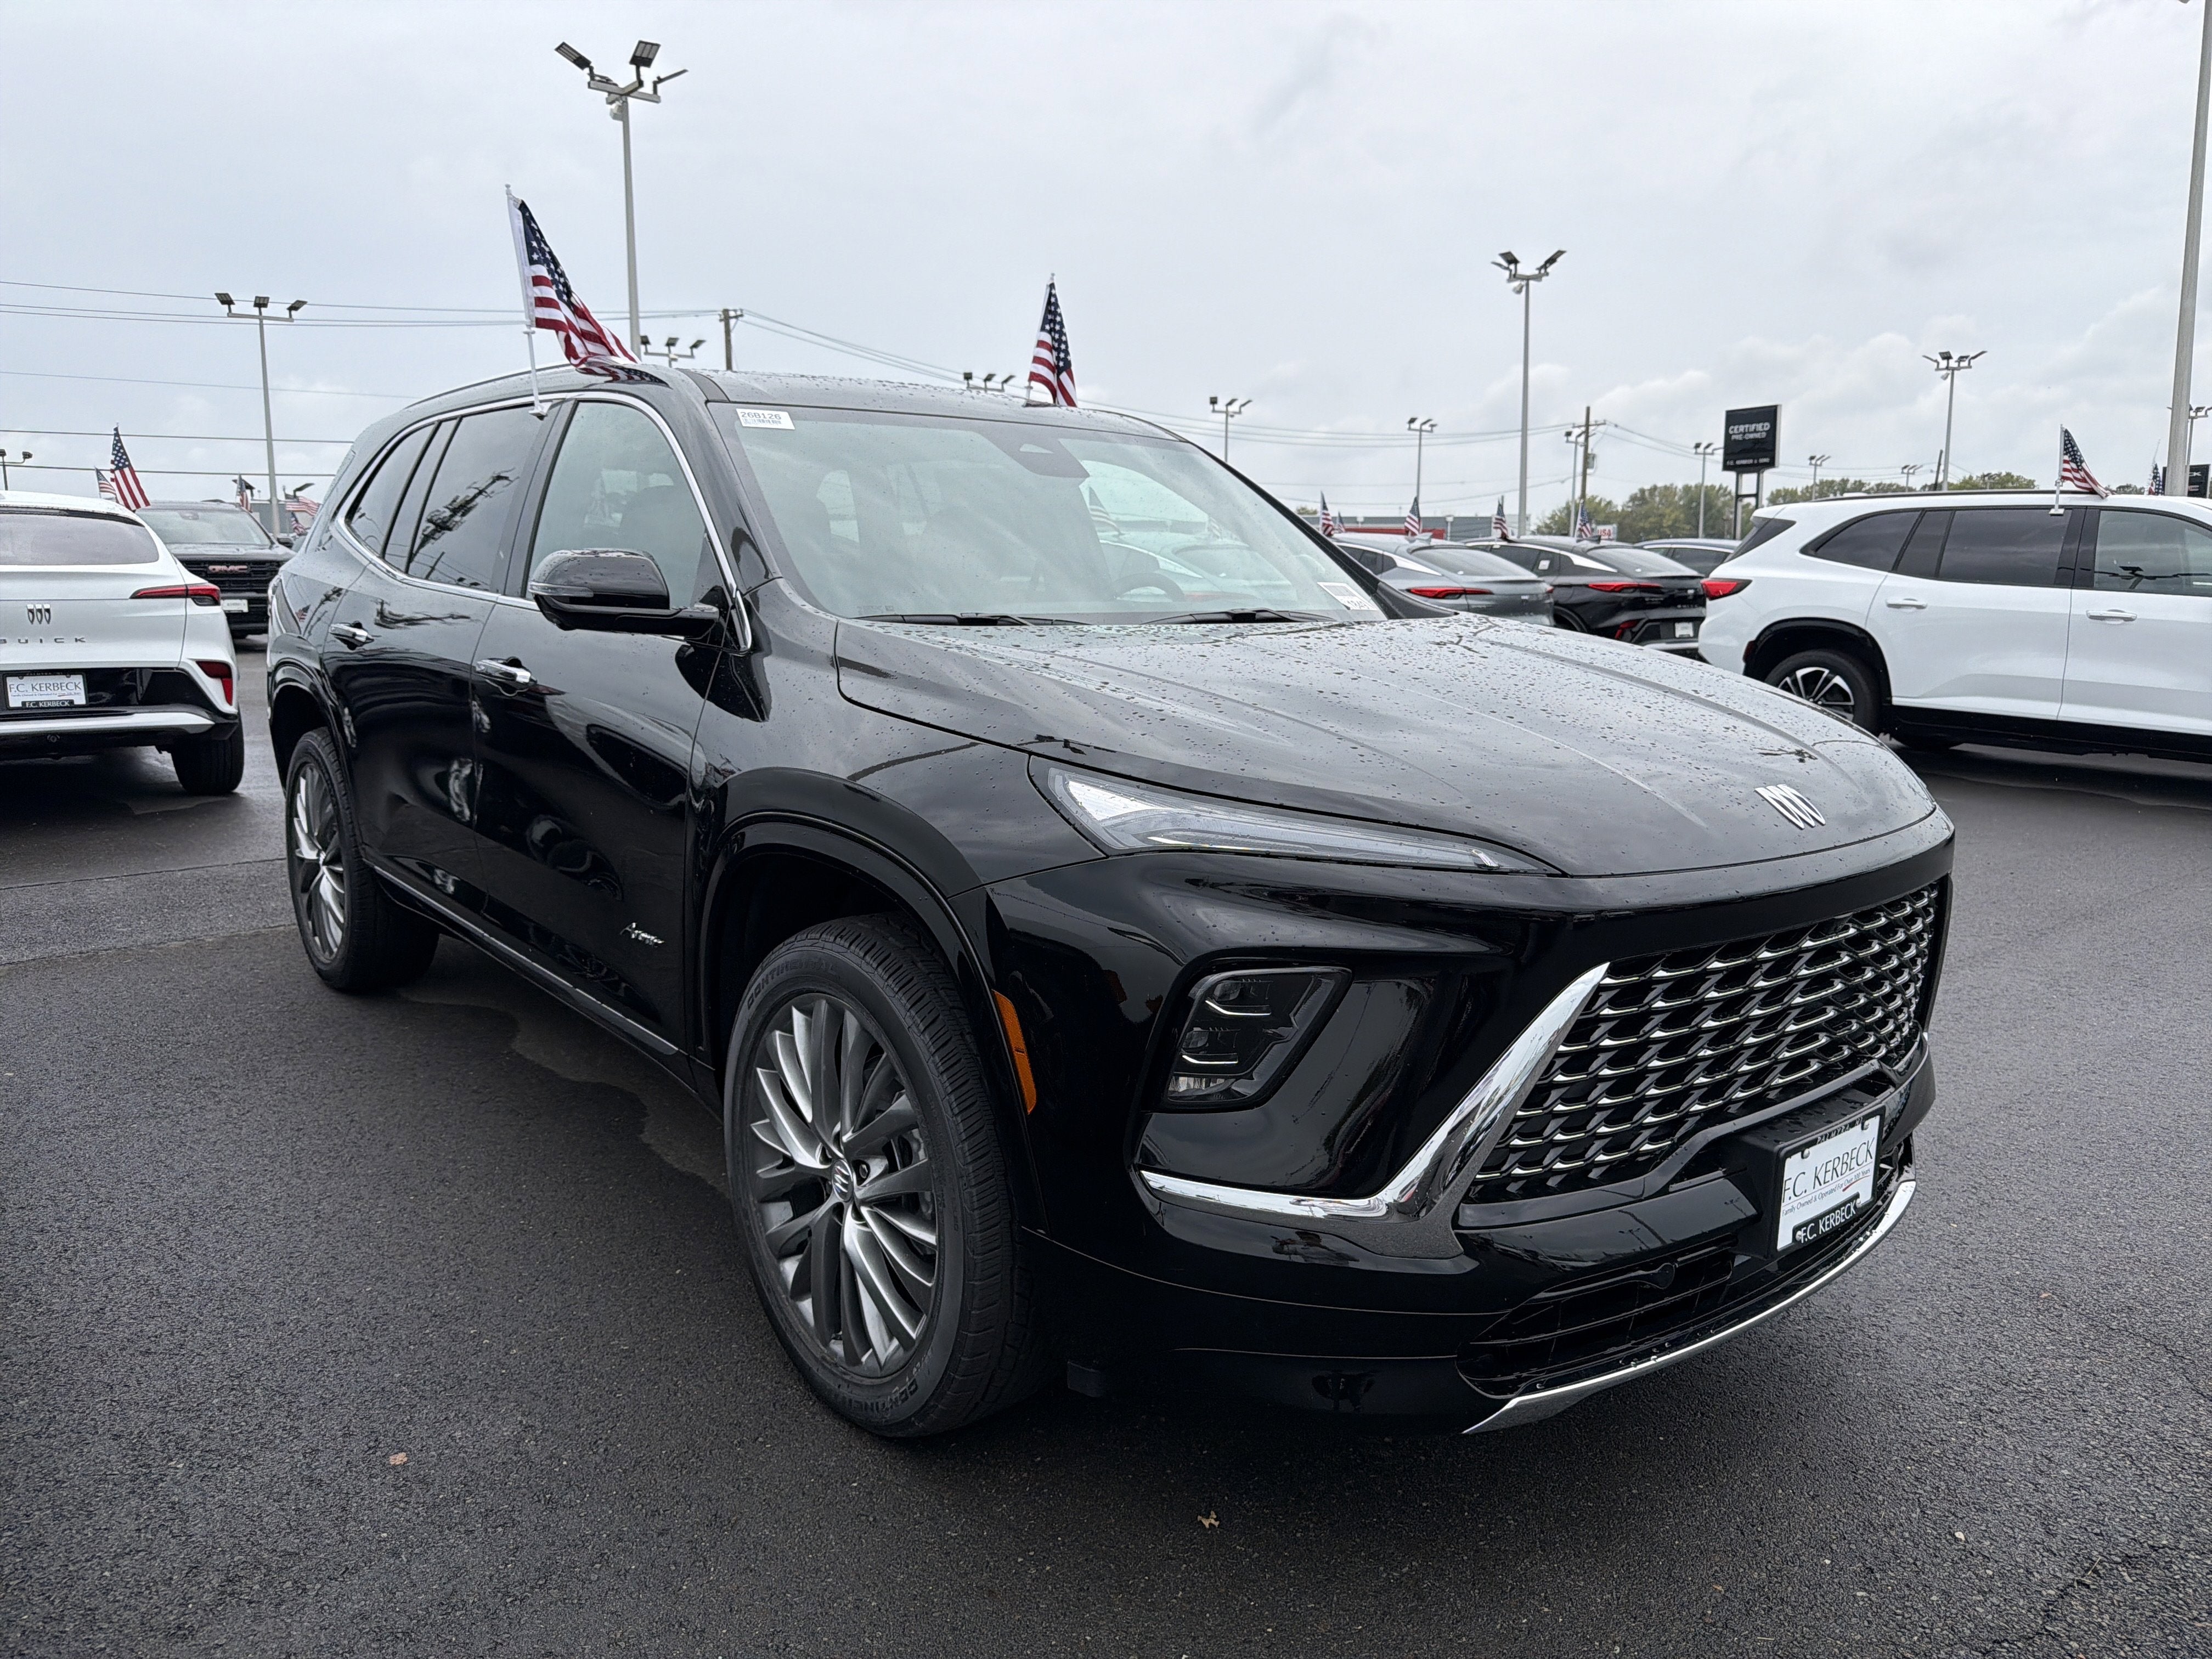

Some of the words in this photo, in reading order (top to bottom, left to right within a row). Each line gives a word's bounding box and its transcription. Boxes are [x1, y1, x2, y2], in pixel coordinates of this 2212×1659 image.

[740, 411, 782, 420] 26B126
[1729, 422, 1770, 435] CERTIFIED
[9, 684, 29, 692] F.C.
[31, 681, 82, 692] KERBECK
[1816, 1124, 1850, 1145] PALMYRA
[1782, 1172, 1807, 1203] F.C.
[1813, 1137, 1875, 1189] KERBECK
[1782, 1206, 1796, 1217] Family
[1797, 1197, 1813, 1210] Owned
[1818, 1185, 1837, 1201] Operated
[1844, 1177, 1853, 1187] Over
[1861, 1168, 1871, 1178] Years
[1801, 1223, 1817, 1244] F.C.
[1819, 1199, 1856, 1234] KERBECK
